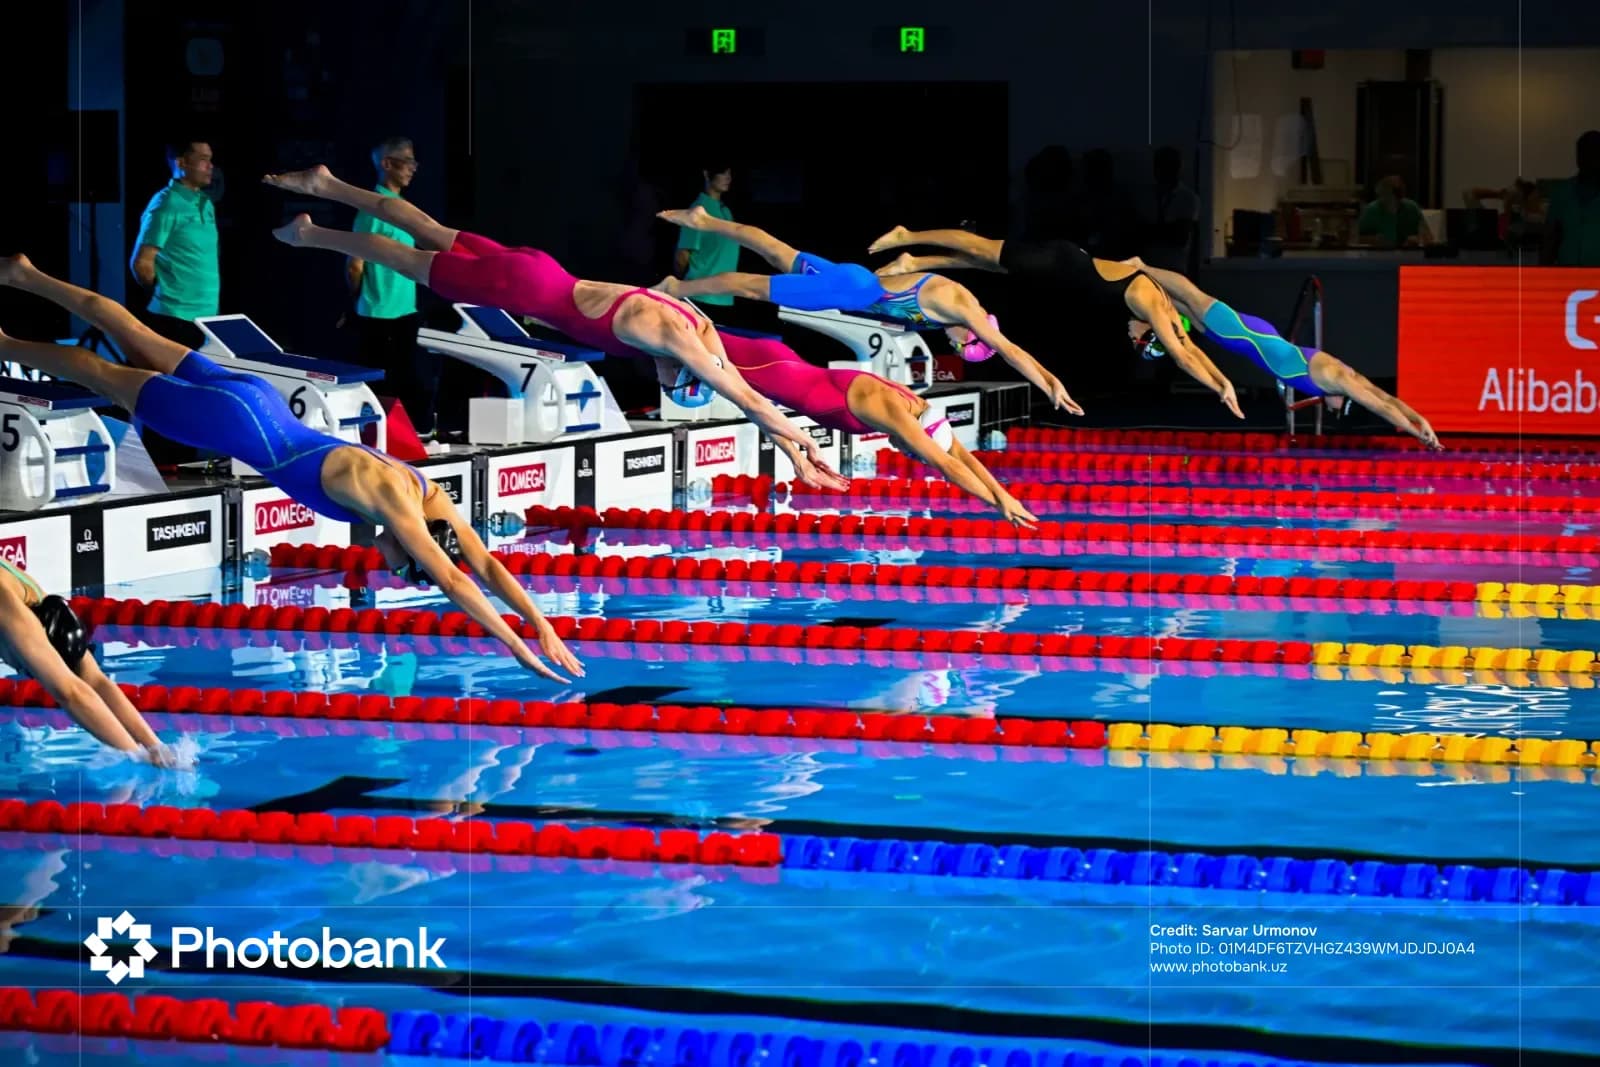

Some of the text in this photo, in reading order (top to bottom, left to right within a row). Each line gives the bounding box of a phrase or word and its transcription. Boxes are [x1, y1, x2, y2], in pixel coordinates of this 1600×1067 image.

[868, 333, 883, 358] 9
[520, 363, 537, 392] 7
[289, 386, 306, 420] 6
[1478, 367, 1600, 414] Alibab
[2, 413, 20, 452] 5
[704, 441, 735, 461] OMEGA
[510, 468, 545, 491] OMEGA
[269, 503, 315, 528] OMEGA
[151, 520, 207, 541] TASHKENT
[0, 543, 26, 567] GA
